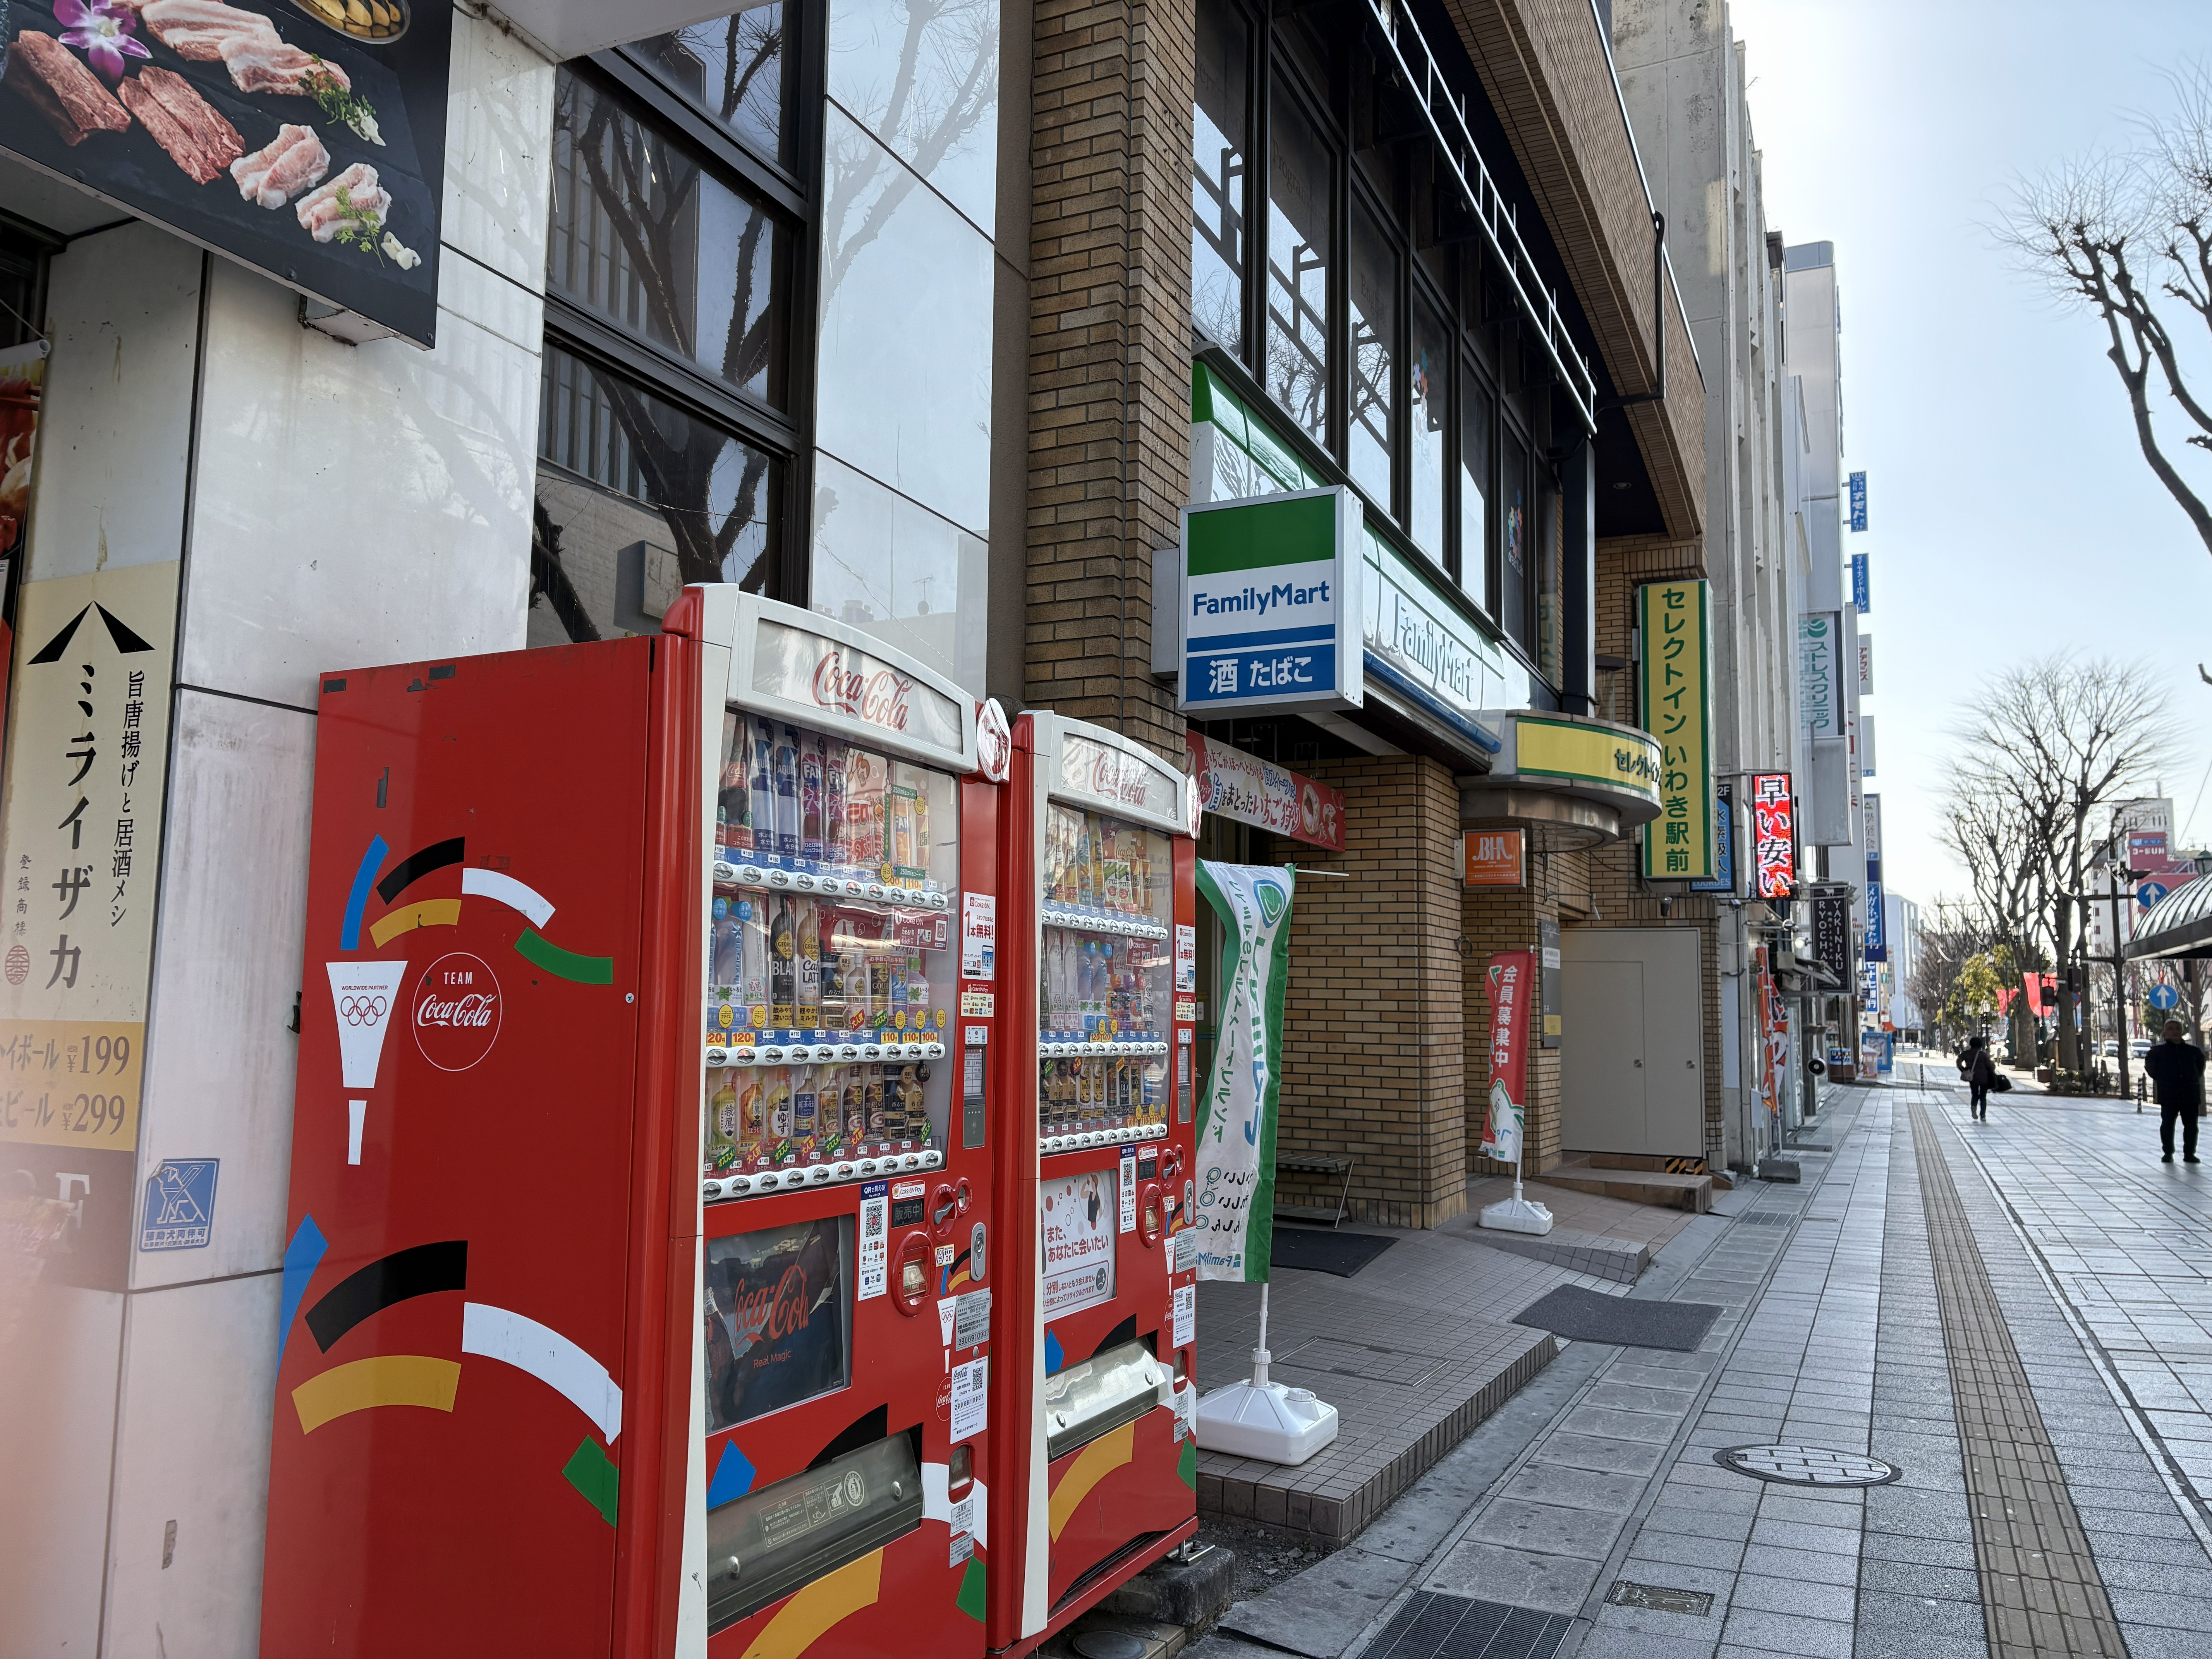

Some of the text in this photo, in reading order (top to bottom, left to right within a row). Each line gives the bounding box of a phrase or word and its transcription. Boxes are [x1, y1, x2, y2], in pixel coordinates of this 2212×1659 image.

[1194, 580, 1329, 616] FamilyMart
[1395, 593, 1475, 702] FamilyMart
[1209, 657, 1313, 694] 酒 たばこ
[812, 651, 914, 731] Coca-Cola
[1092, 751, 1146, 808] Coca-Cola
[1717, 786, 1730, 796] 2F
[111, 670, 144, 927] 旨唐揚げと居酒メシ
[46, 665, 96, 989] ミライザカ
[1755, 778, 1791, 897] 早い安い
[1819, 901, 1828, 961] RYOCHA
[1834, 900, 1843, 970] YAKINIKU
[444, 972, 473, 985] TEAM
[417, 994, 498, 1027] Coca-Cola
[1495, 965, 1518, 1068] 会員募集中
[733, 1032, 754, 1043] 120円
[882, 1033, 897, 1042] 110円
[904, 1033, 918, 1041] 110円
[922, 1032, 937, 1041] 100円
[0, 1090, 55, 1128] ビール
[725, 1104, 734, 1129] 綾鷹
[777, 1112, 788, 1135] ゆず
[801, 1139, 815, 1154] 大人気
[851, 1130, 864, 1147] 大人気
[747, 1146, 762, 1162] 大人気
[895, 1204, 921, 1221] 販売中
[1047, 1225, 1066, 1243] また、
[1048, 1235, 1109, 1263] あなたに会いたい
[734, 1264, 809, 1348] Coca-Cola
[753, 1350, 791, 1369] Real Magic
